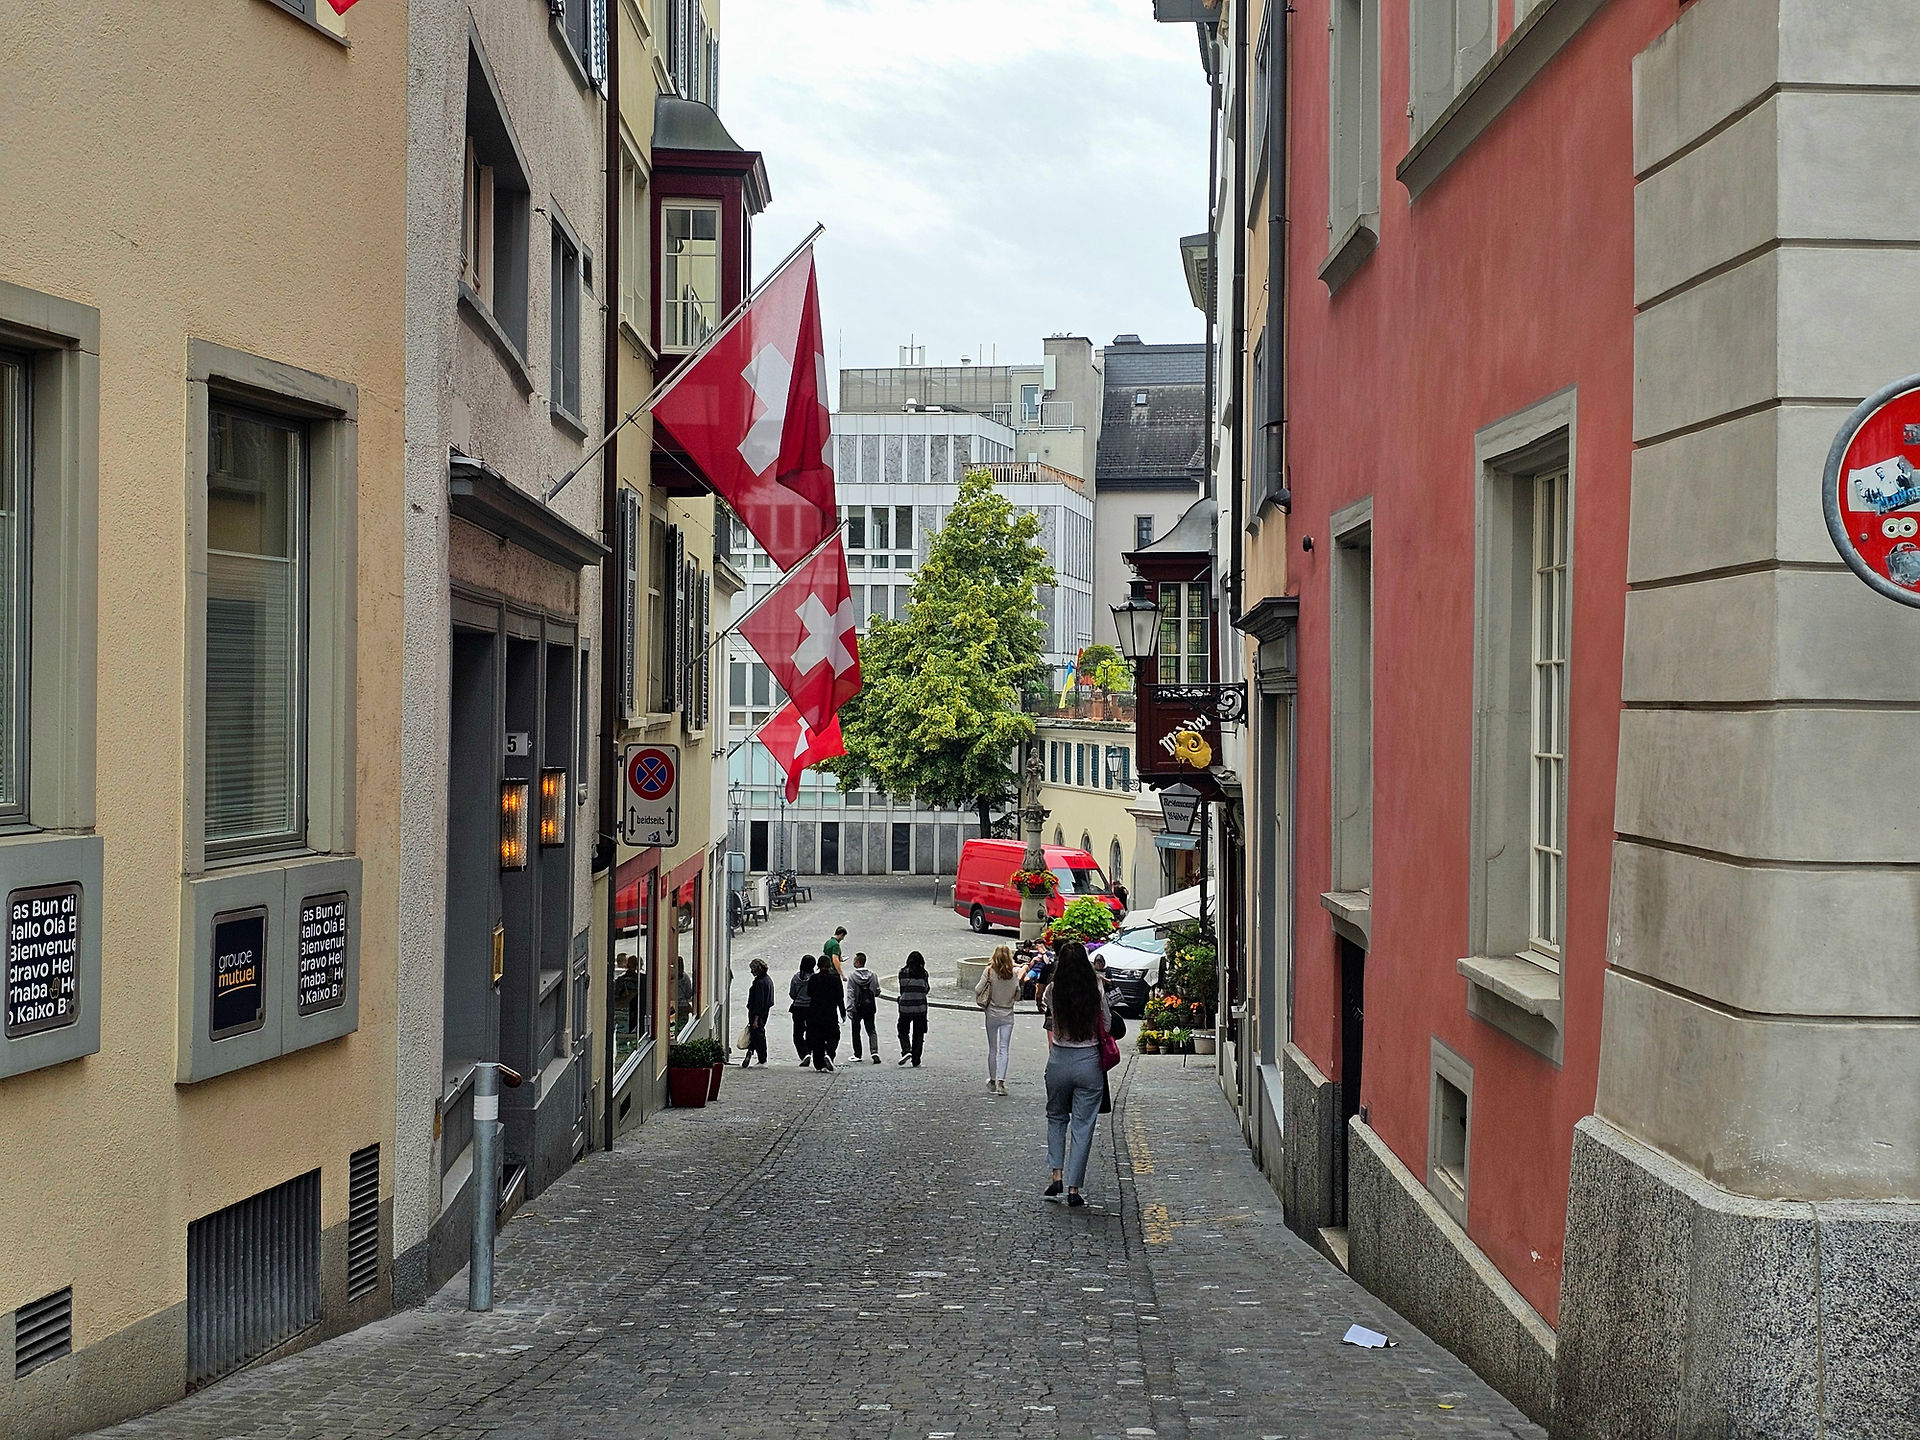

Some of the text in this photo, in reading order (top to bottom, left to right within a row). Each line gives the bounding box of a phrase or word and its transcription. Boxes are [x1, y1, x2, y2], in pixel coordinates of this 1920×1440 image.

[507, 735, 517, 753] 5
[636, 815, 665, 825] beidseits
[13, 903, 29, 920] as
[32, 898, 59, 917] Bun
[303, 909, 314, 922] as
[315, 905, 333, 920] Bun
[43, 915, 66, 936] Olá
[323, 917, 338, 935] Olá
[9, 955, 74, 984] dravo Hel
[218, 949, 253, 973] groupe
[301, 950, 343, 973] dravo Hel
[218, 965, 255, 988] mutuel
[306, 987, 330, 1005] Kaixo
[17, 1001, 54, 1024] Kaixo
